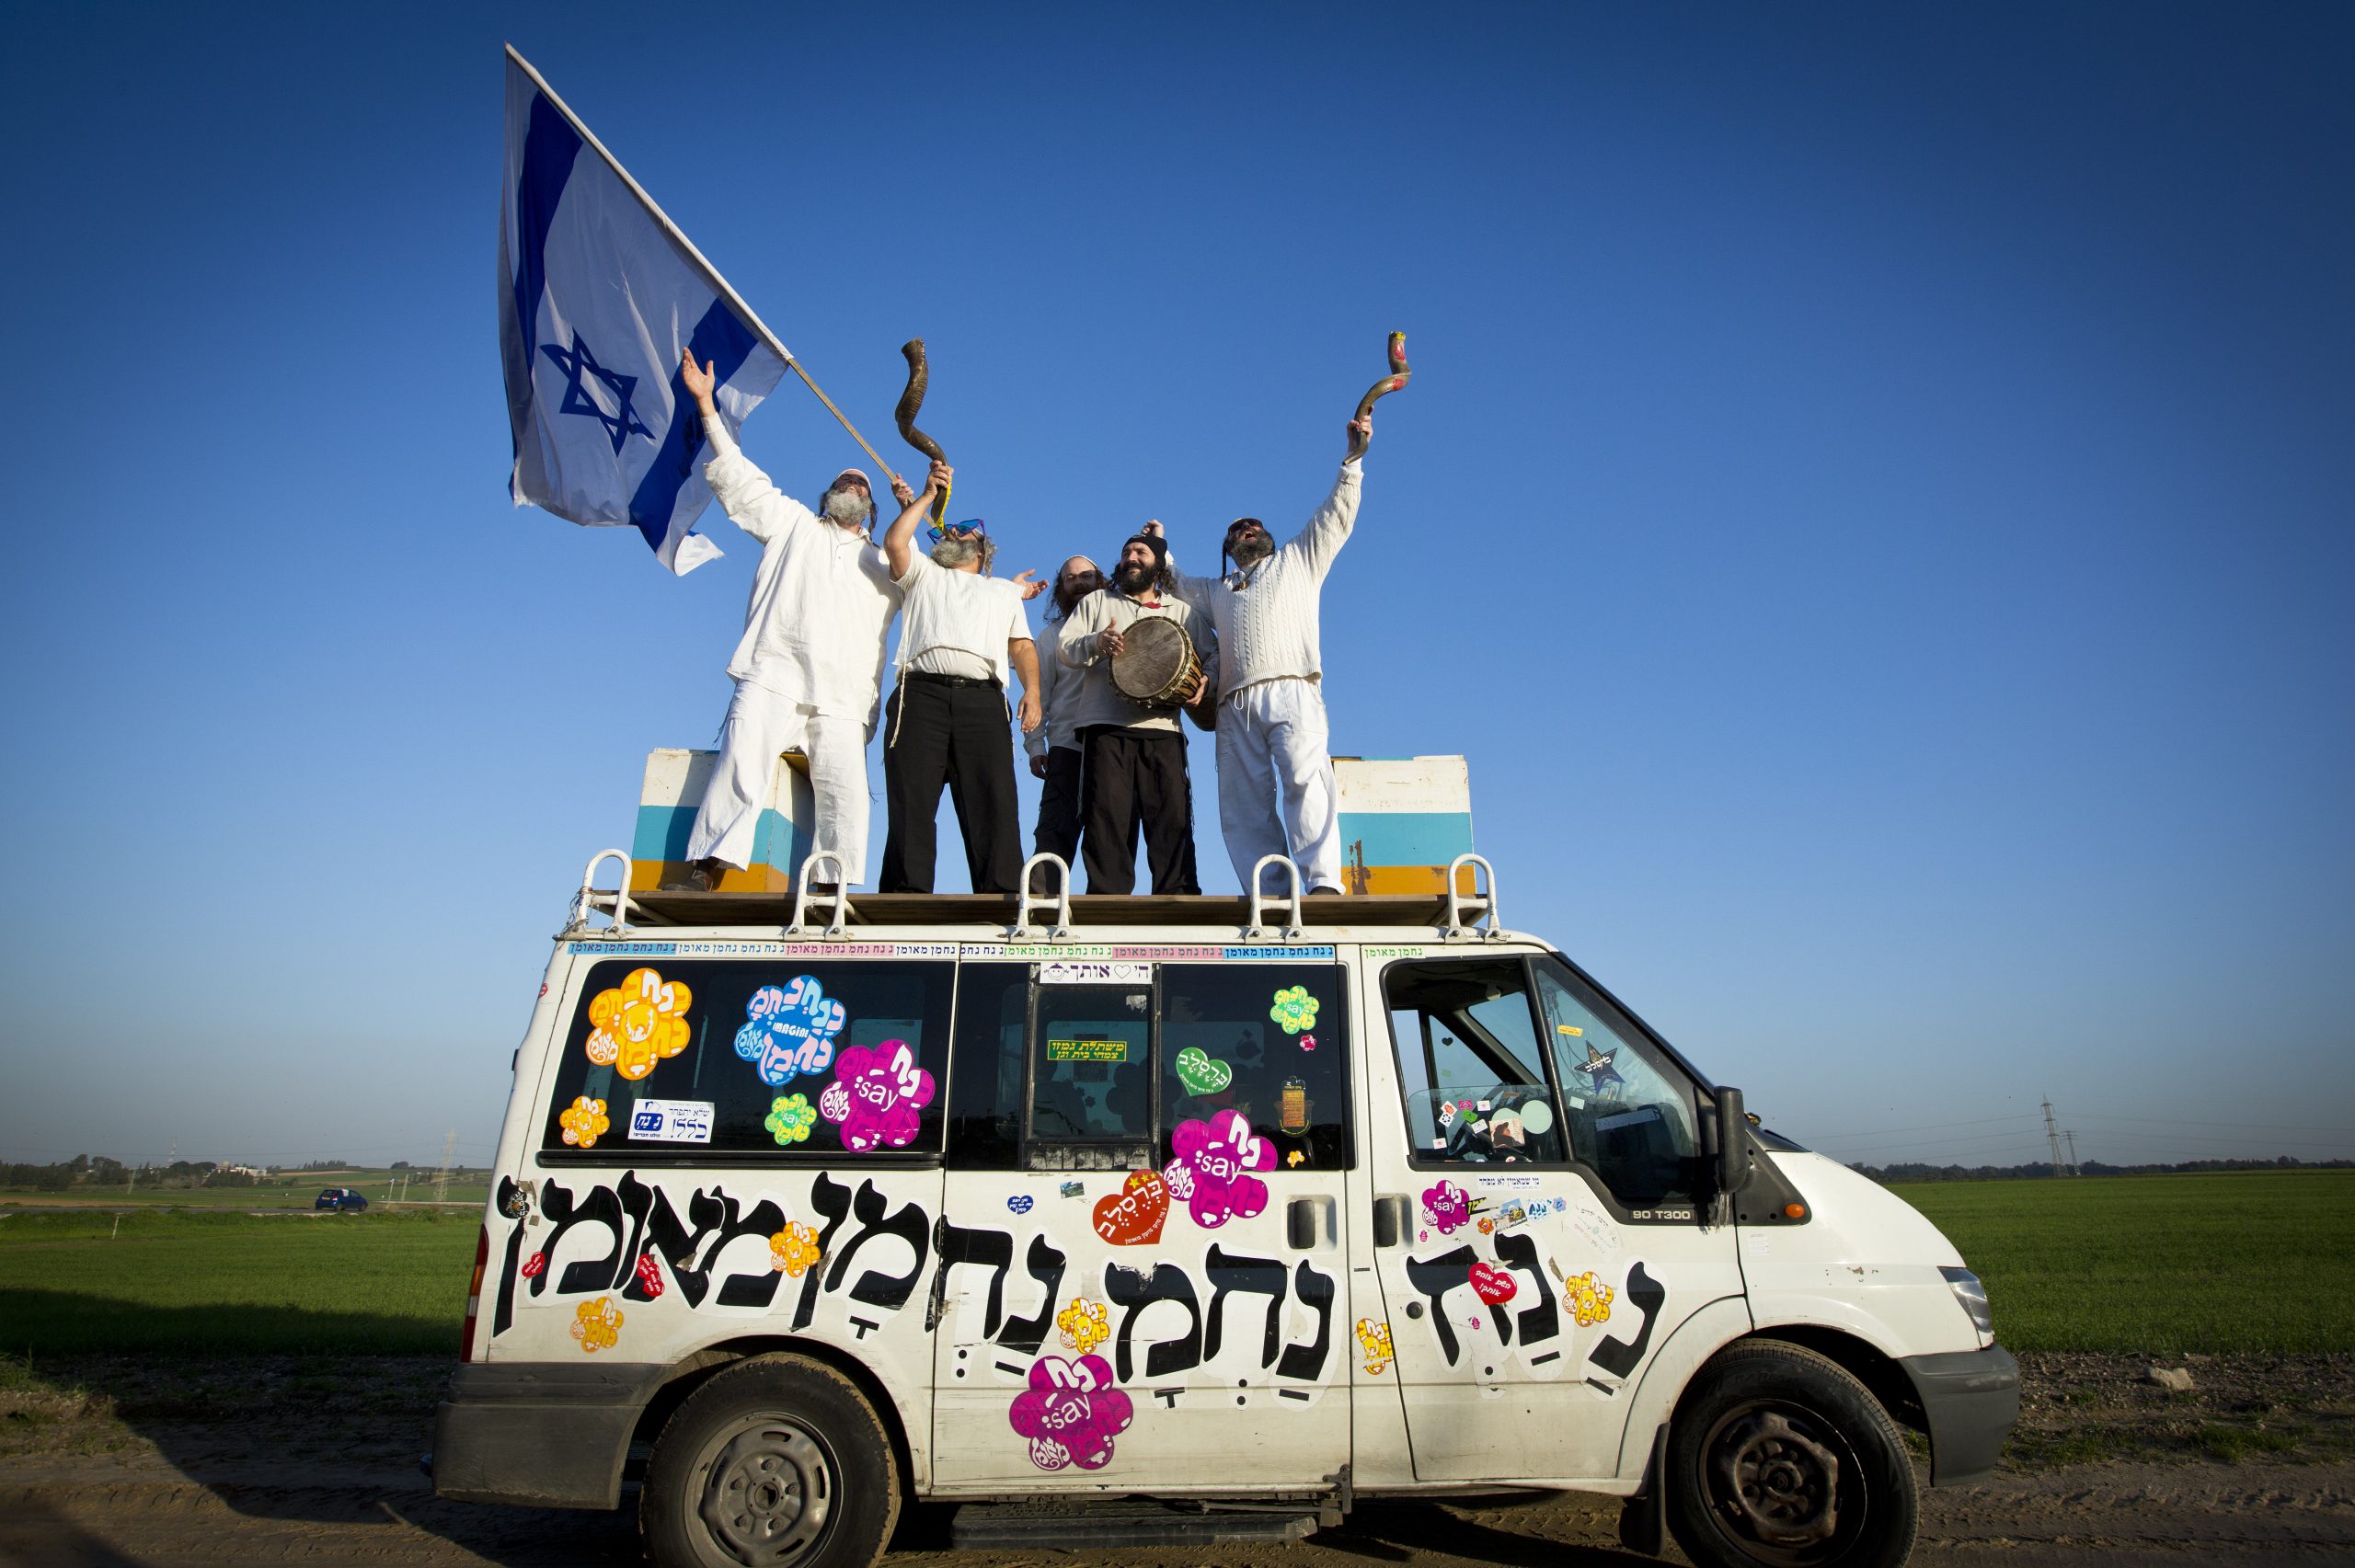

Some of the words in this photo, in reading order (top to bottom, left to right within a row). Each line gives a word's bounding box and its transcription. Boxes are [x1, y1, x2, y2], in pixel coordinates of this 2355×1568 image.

[1070, 965, 1110, 981] אותך
[1287, 1004, 1304, 1017] say
[859, 1082, 898, 1111] say
[782, 1113, 800, 1127] say
[1200, 1154, 1241, 1185] say
[1437, 1202, 1455, 1214] say
[1633, 1210, 1651, 1219] 90
[1655, 1210, 1691, 1219] T300
[1051, 1394, 1091, 1429] say
